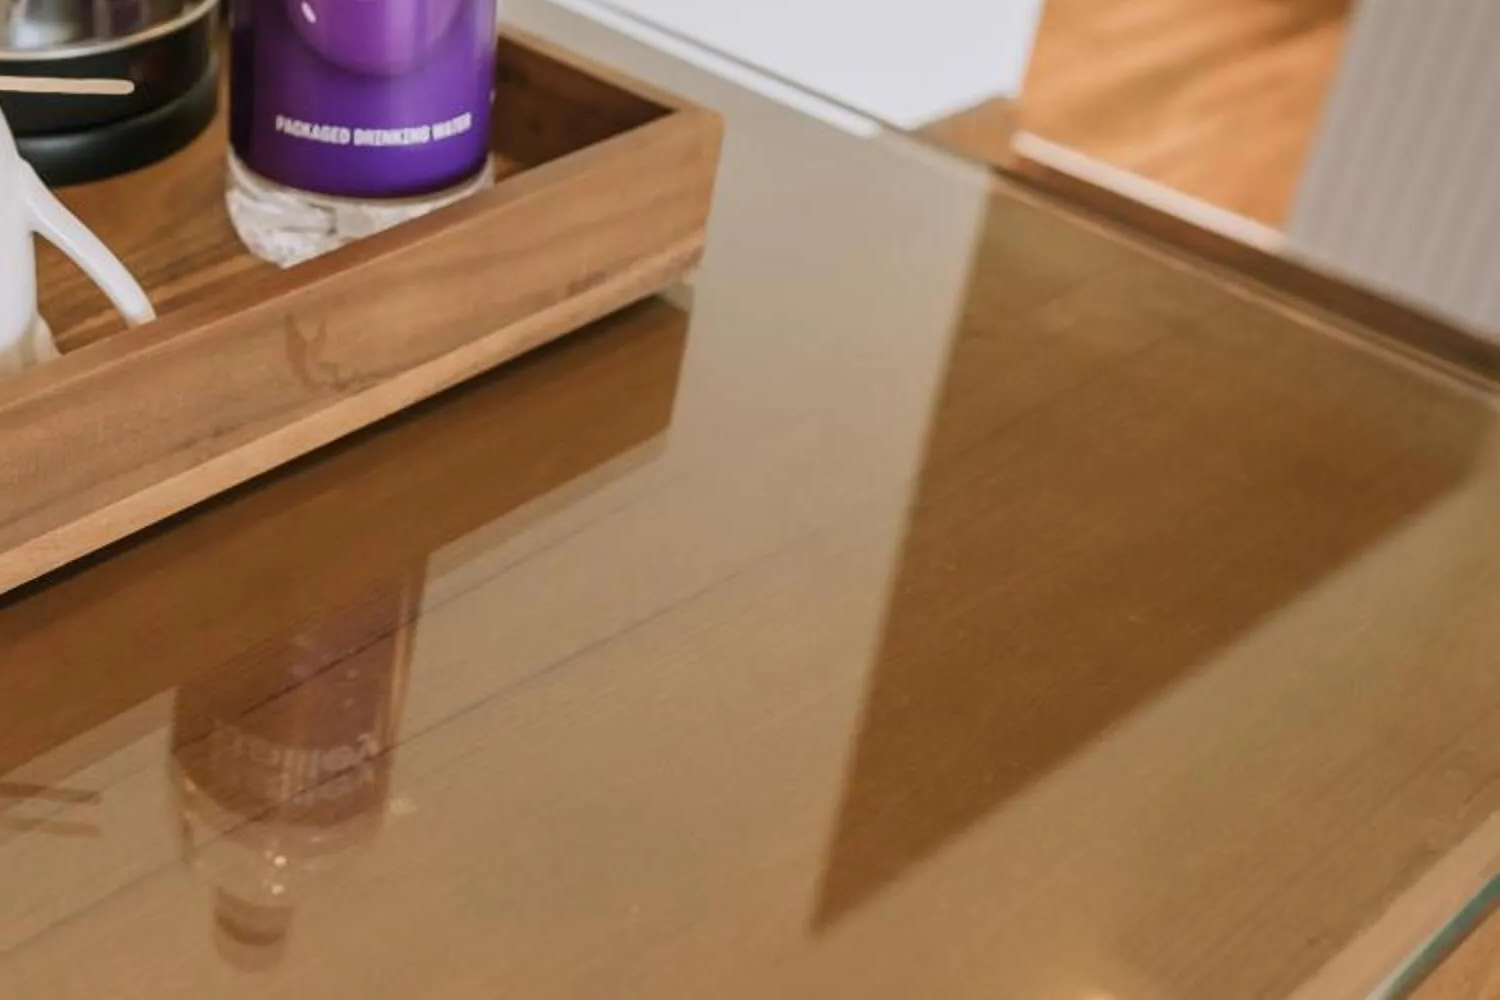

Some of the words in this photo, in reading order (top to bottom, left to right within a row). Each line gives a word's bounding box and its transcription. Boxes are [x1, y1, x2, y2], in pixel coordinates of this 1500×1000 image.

[276, 115, 350, 144] PACKAGED
[353, 126, 430, 146] DRINKING
[432, 112, 472, 140] WATER
